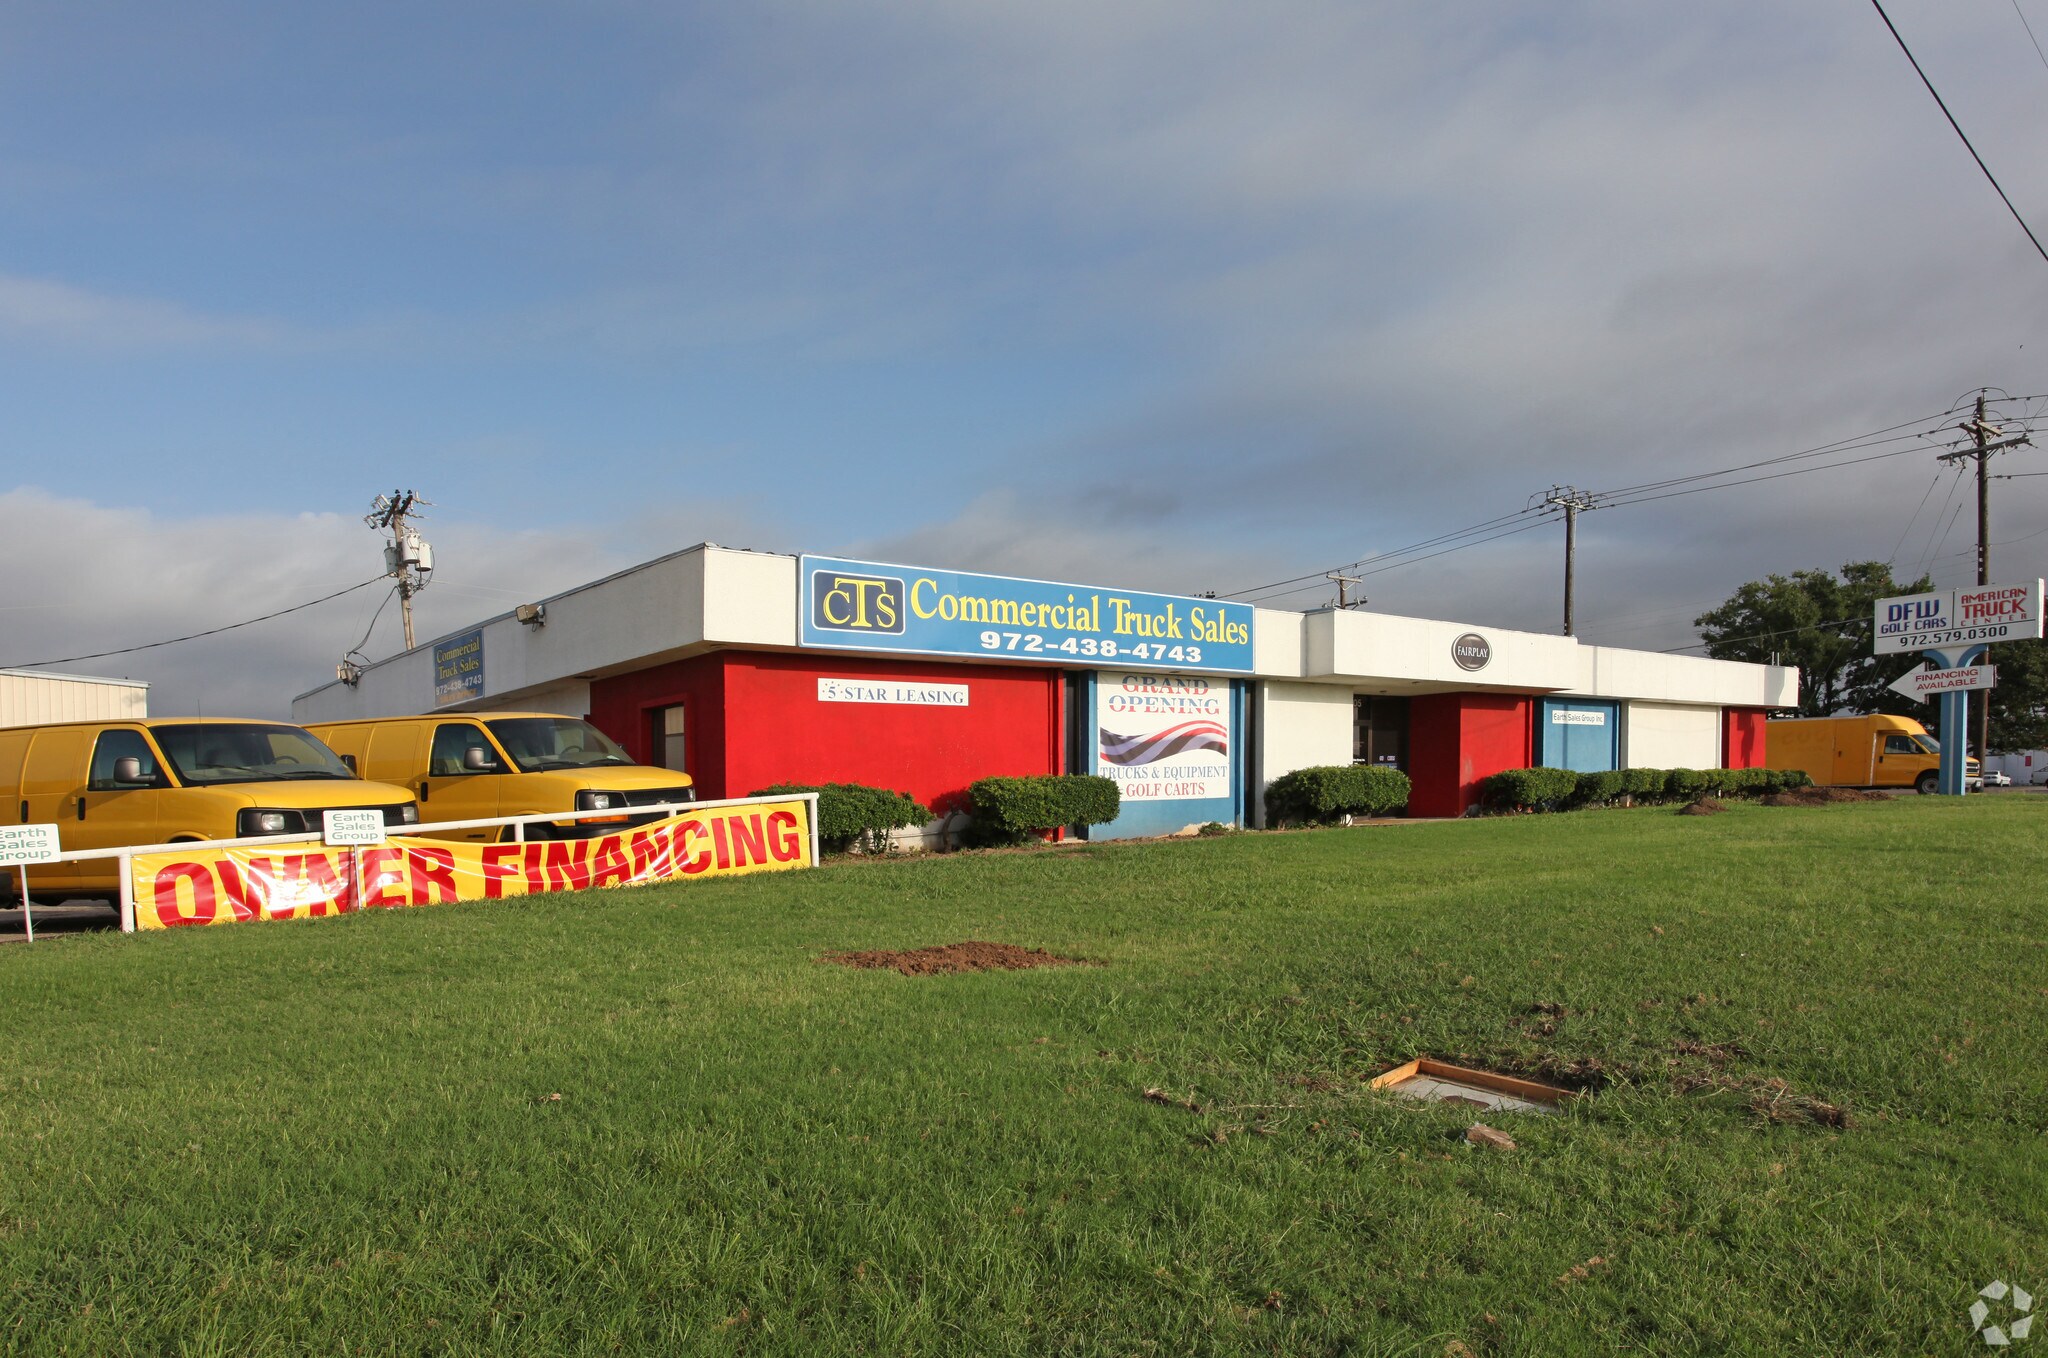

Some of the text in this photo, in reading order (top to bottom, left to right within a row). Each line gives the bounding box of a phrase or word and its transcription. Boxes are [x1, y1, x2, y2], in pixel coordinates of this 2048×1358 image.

[1961, 587, 2028, 604] AMERICAN
[910, 578, 1249, 645] Commercial Truck Sales
[1888, 599, 1940, 622] DFW
[1961, 598, 2026, 619] TRUCK
[1880, 617, 1947, 634] GOLF CARS
[1960, 614, 2028, 627] CENTER
[1900, 625, 2008, 647] 972.579.0300
[436, 636, 480, 663] Commercial
[980, 631, 1202, 663] 972-438-4743
[1457, 645, 1489, 658] FAIRPLAY
[438, 657, 479, 679] Truck Sales
[1915, 668, 1979, 682] FINANCING
[435, 674, 482, 696] 972-438-4743
[1122, 675, 1209, 695] GRAND
[1916, 677, 1977, 691] AVAILABLE
[828, 686, 964, 704] 5 STAR LEASING
[1108, 695, 1220, 715] OPENING
[1553, 712, 1567, 721] Earth
[1567, 713, 1581, 722] Sales
[1581, 714, 1595, 723] Group
[1101, 766, 1228, 781] TRUCKS & EQUIPMENT
[1126, 782, 1205, 798] GOLF CARTS
[332, 813, 375, 822] Earth
[0, 828, 47, 840] arth
[333, 822, 376, 831] Sales
[332, 831, 379, 841] Group
[154, 810, 801, 928] OWNER FINANCING
